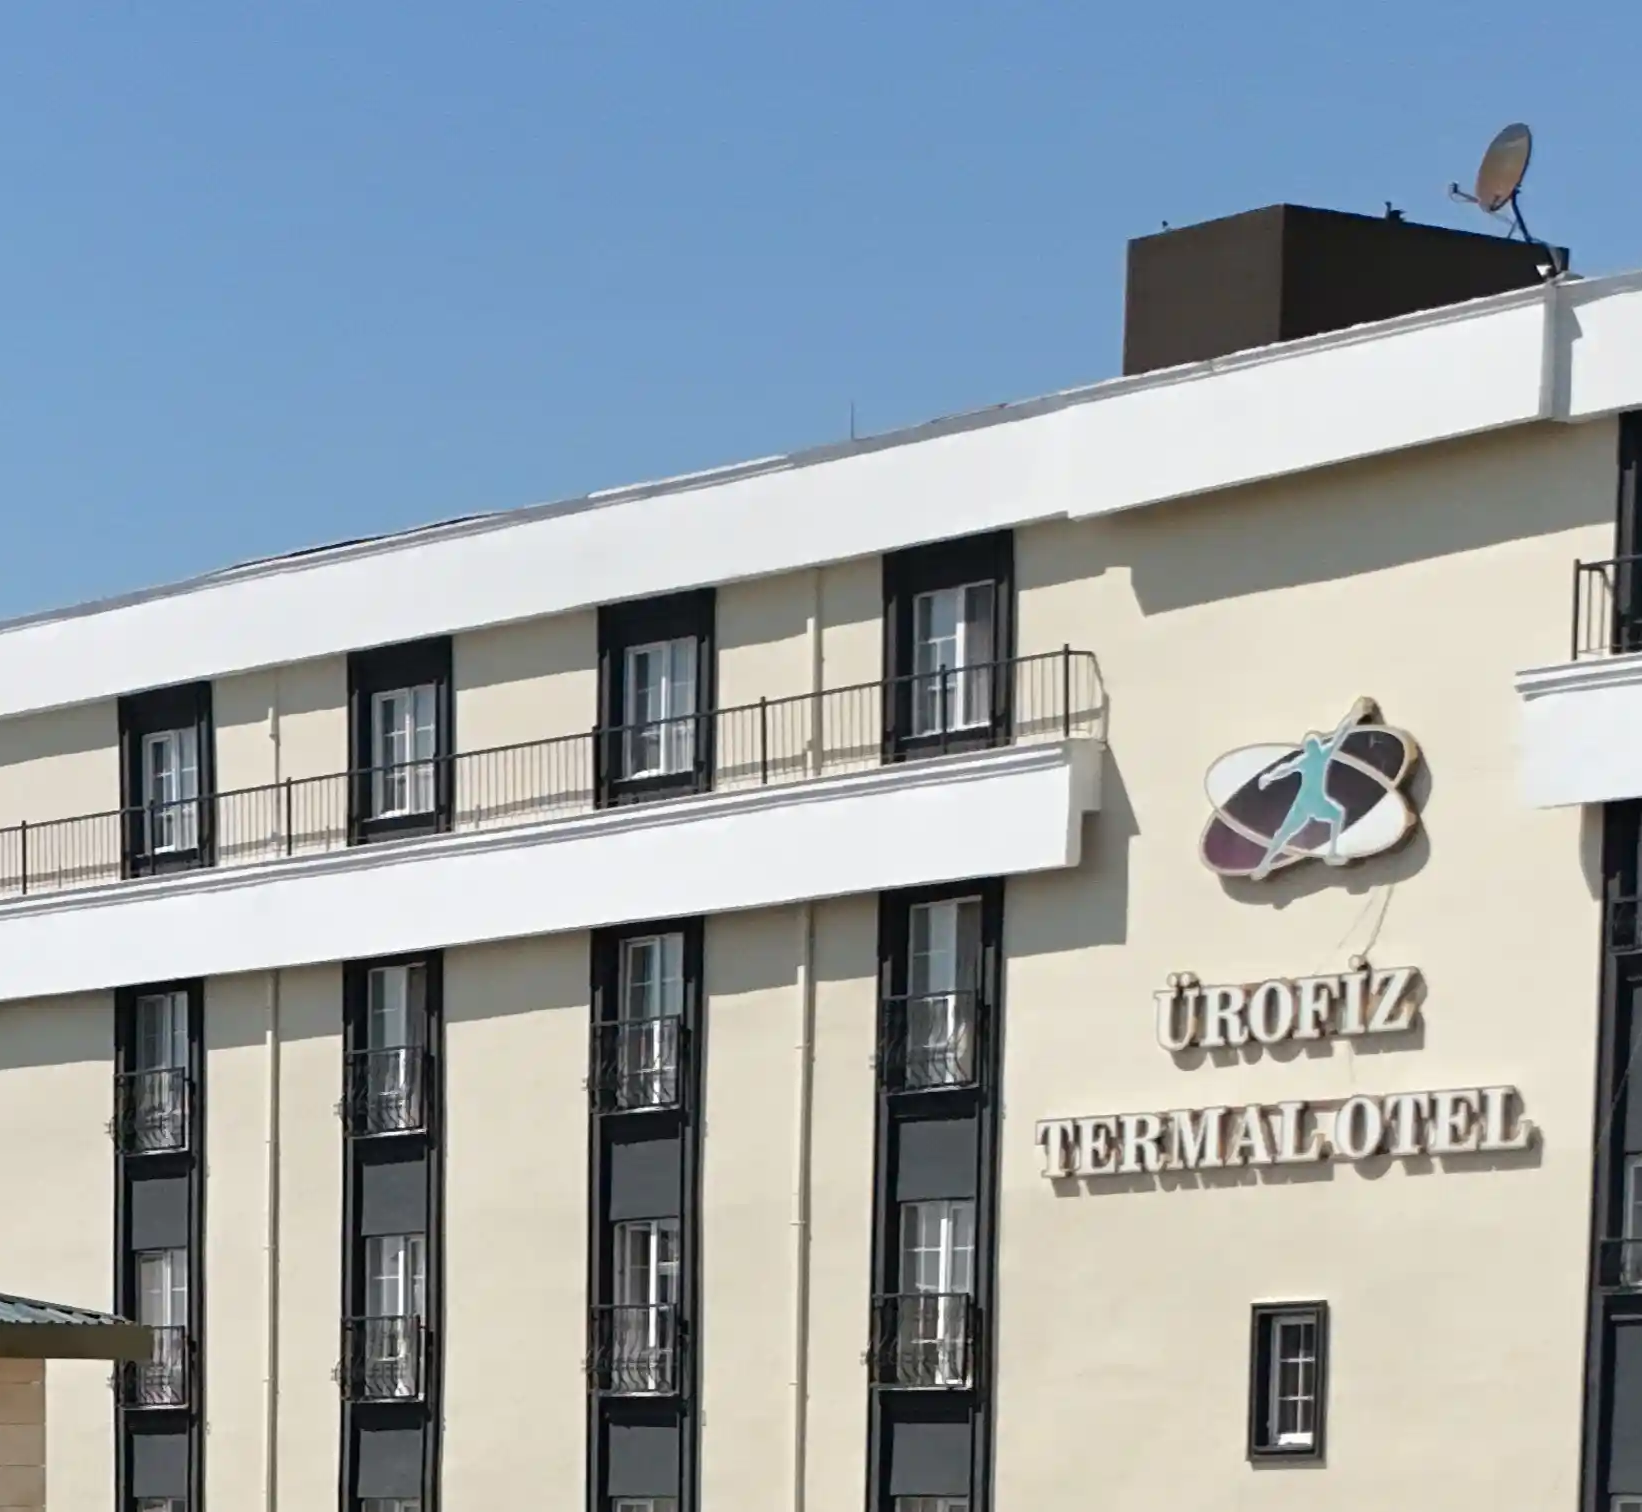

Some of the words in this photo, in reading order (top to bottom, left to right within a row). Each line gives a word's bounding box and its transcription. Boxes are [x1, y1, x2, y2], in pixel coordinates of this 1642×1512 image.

[1154, 955, 1421, 1052] ÜROFİZ
[1036, 1101, 1319, 1180] TERMAL
[1331, 1085, 1533, 1160] OTEL
